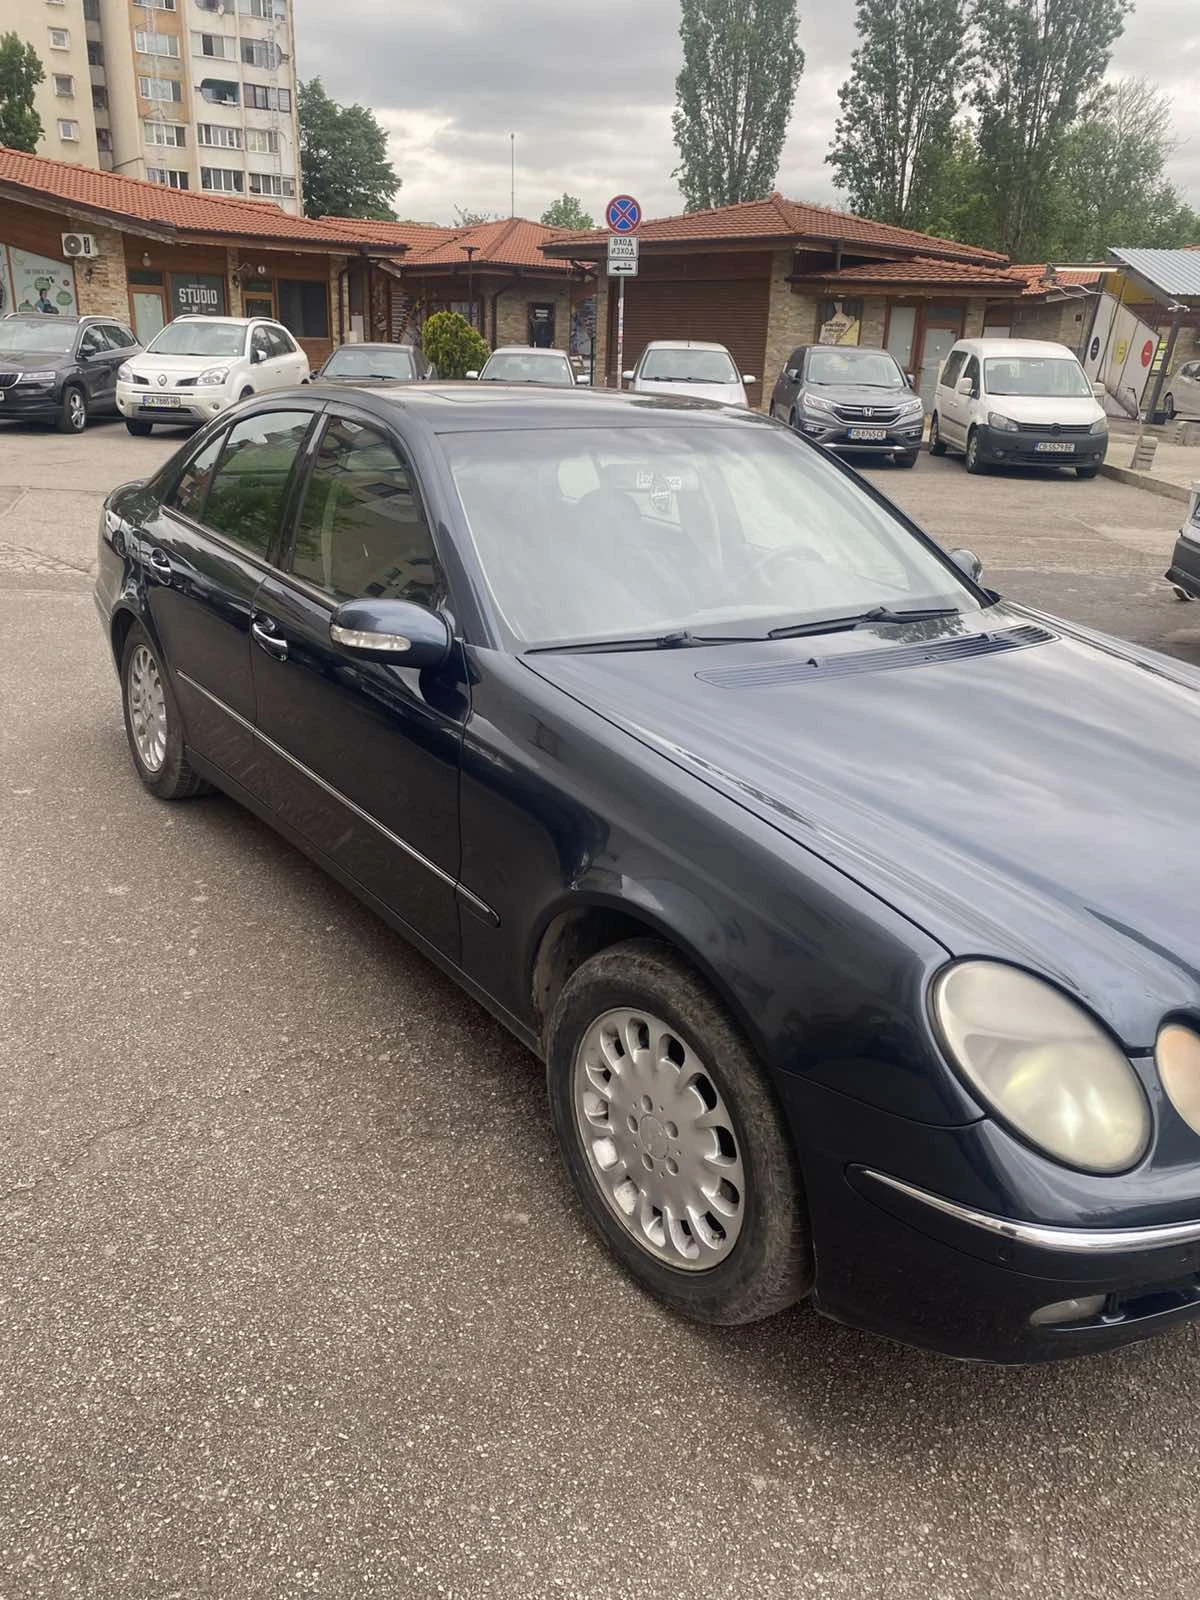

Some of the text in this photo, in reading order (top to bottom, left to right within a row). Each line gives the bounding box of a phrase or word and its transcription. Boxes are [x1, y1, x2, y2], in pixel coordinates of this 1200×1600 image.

[613, 239, 633, 247] ВХОД
[611, 247, 635, 256] ИЗХОД
[178, 287, 218, 305] STUDIO
